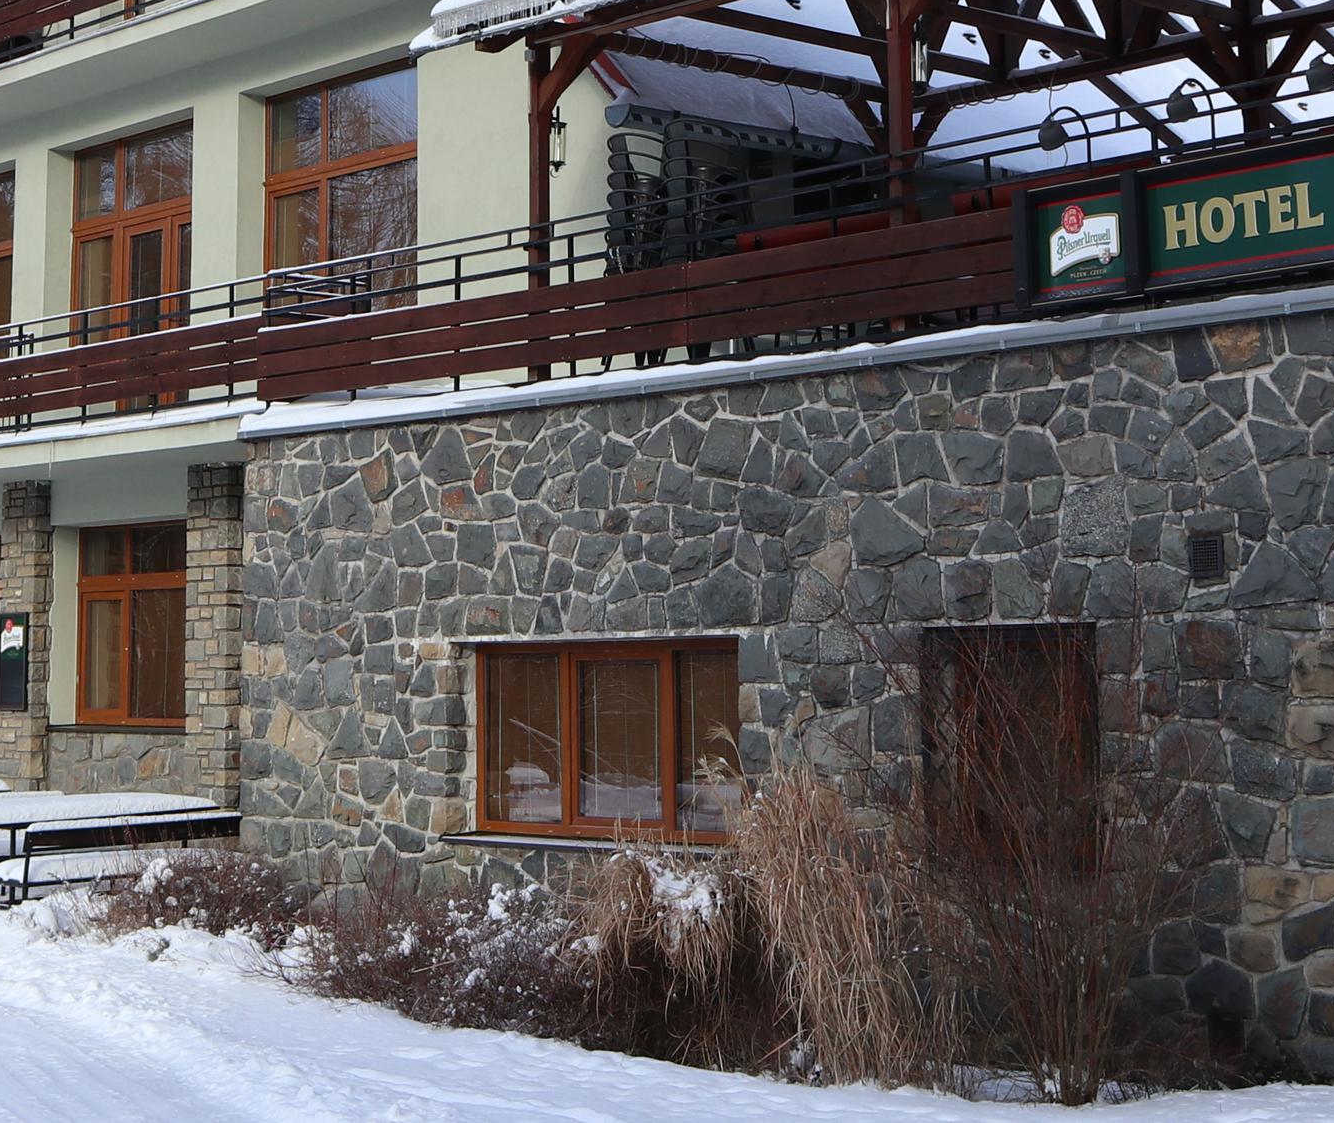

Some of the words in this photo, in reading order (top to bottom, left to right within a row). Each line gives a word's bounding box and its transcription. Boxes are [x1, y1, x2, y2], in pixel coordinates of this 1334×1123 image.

[1163, 182, 1324, 251] HOTEL
[1057, 235, 1084, 260] Pilsner
[1084, 228, 1111, 247] Urquell
